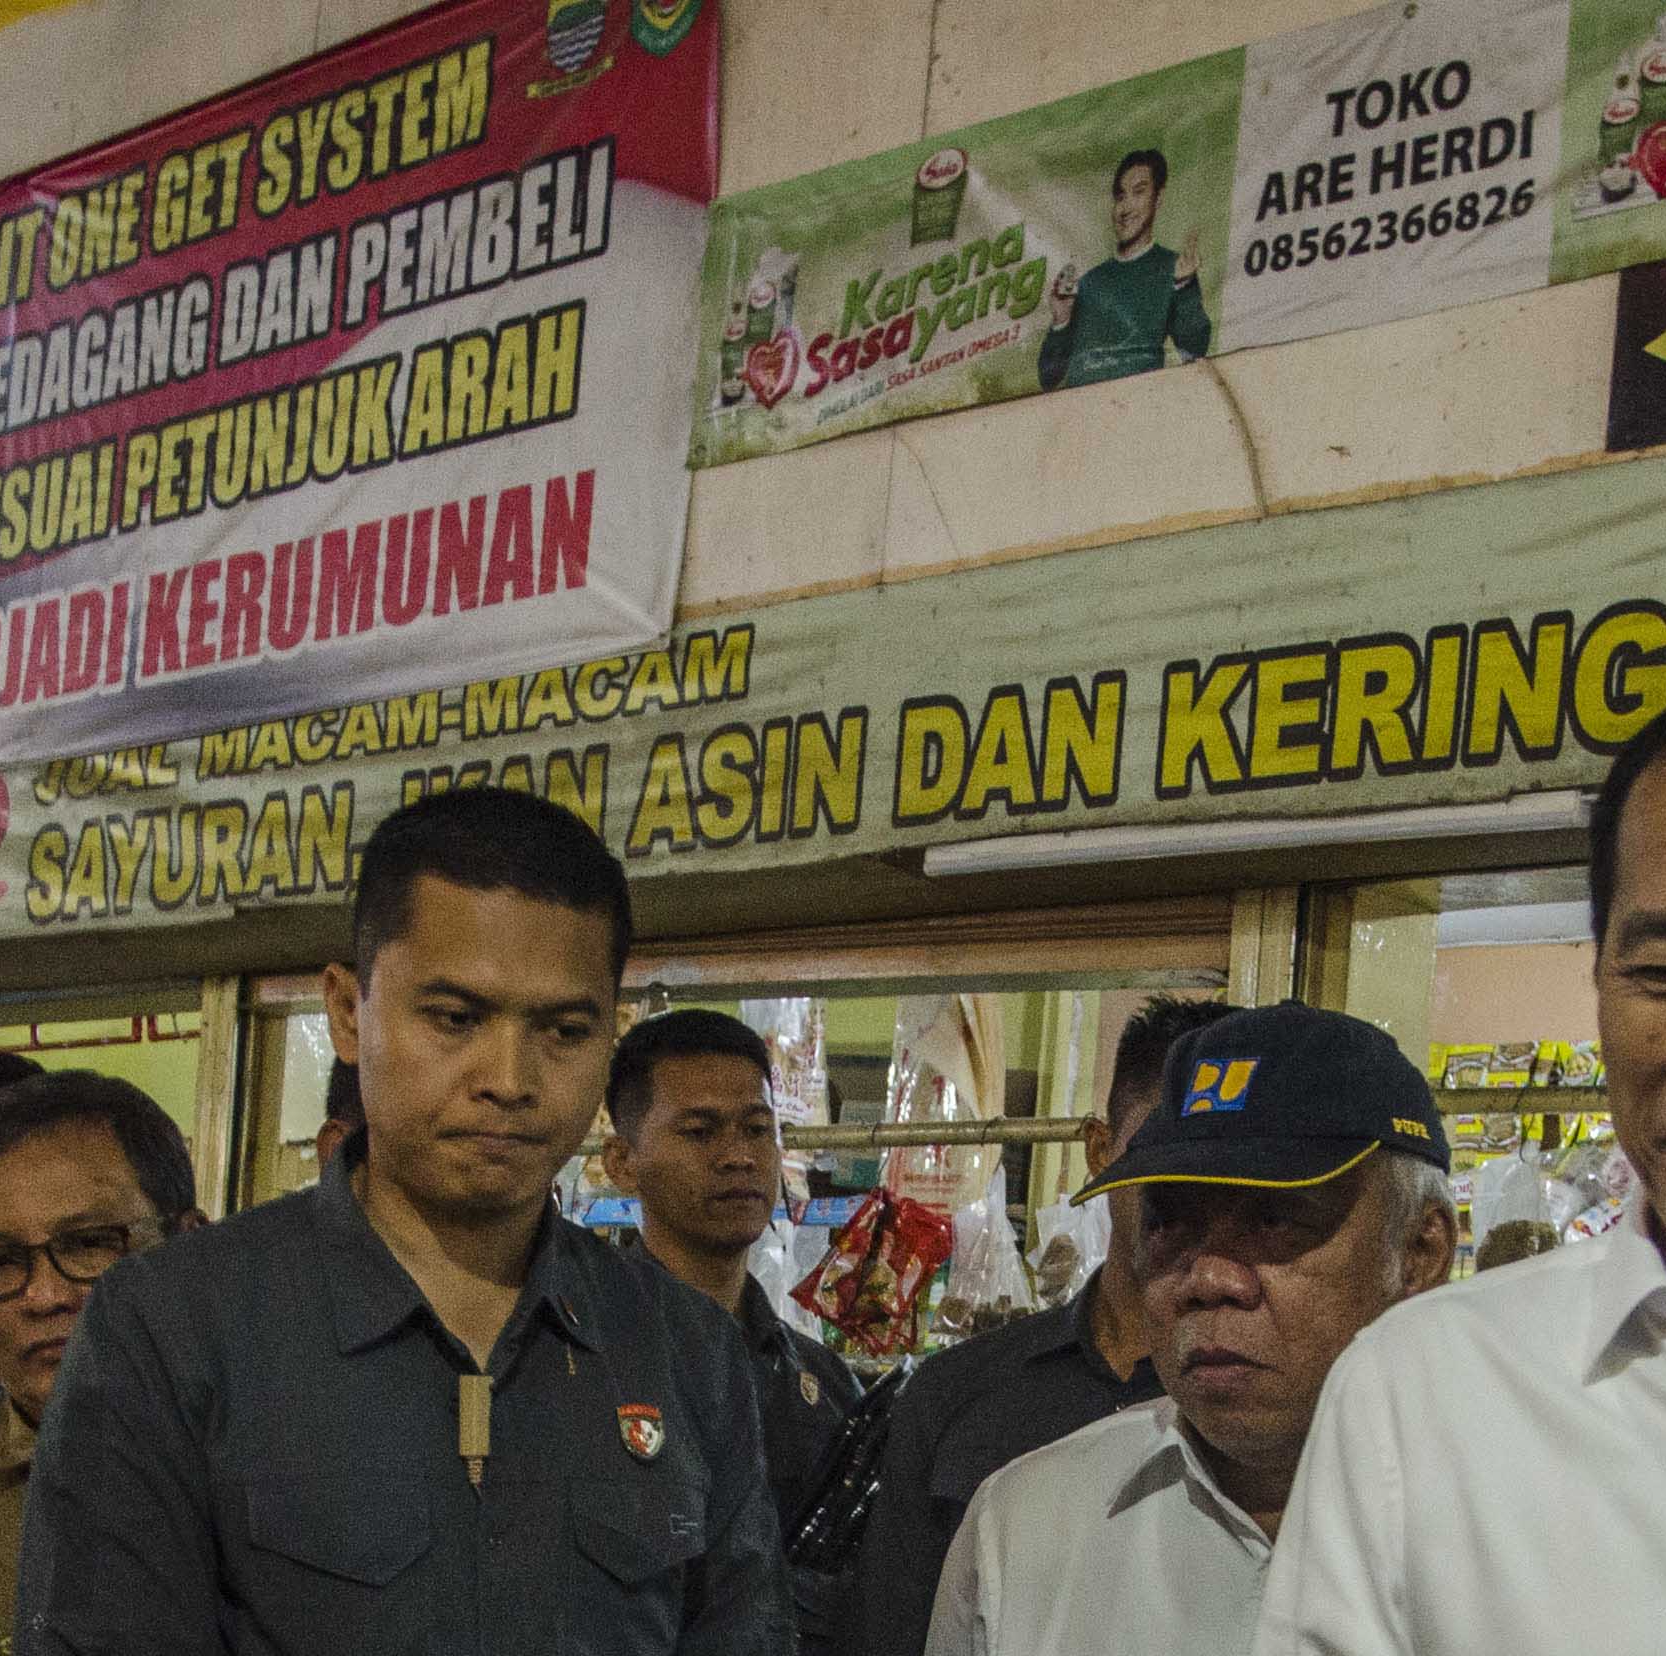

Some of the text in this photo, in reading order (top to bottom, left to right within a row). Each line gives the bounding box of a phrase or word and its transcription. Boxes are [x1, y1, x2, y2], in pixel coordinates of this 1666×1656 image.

[46, 165, 146, 293] ONE
[151, 125, 256, 256] GET
[254, 37, 496, 219] SYSTEM
[1254, 108, 1537, 222] ARE HERDI
[1325, 59, 1472, 138] TOKO
[217, 226, 341, 369] DAN
[341, 136, 617, 331] PEMBELI
[839, 222, 1025, 340] Karena
[1243, 178, 1536, 277] 08562366826
[118, 352, 404, 531] PETUNJUK
[397, 298, 587, 461] ARAH
[139, 468, 597, 680] KERUMUNAN
[195, 623, 757, 782] MACAM-MACAM
[623, 703, 867, 861] ASIN
[890, 670, 1132, 826] DAN
